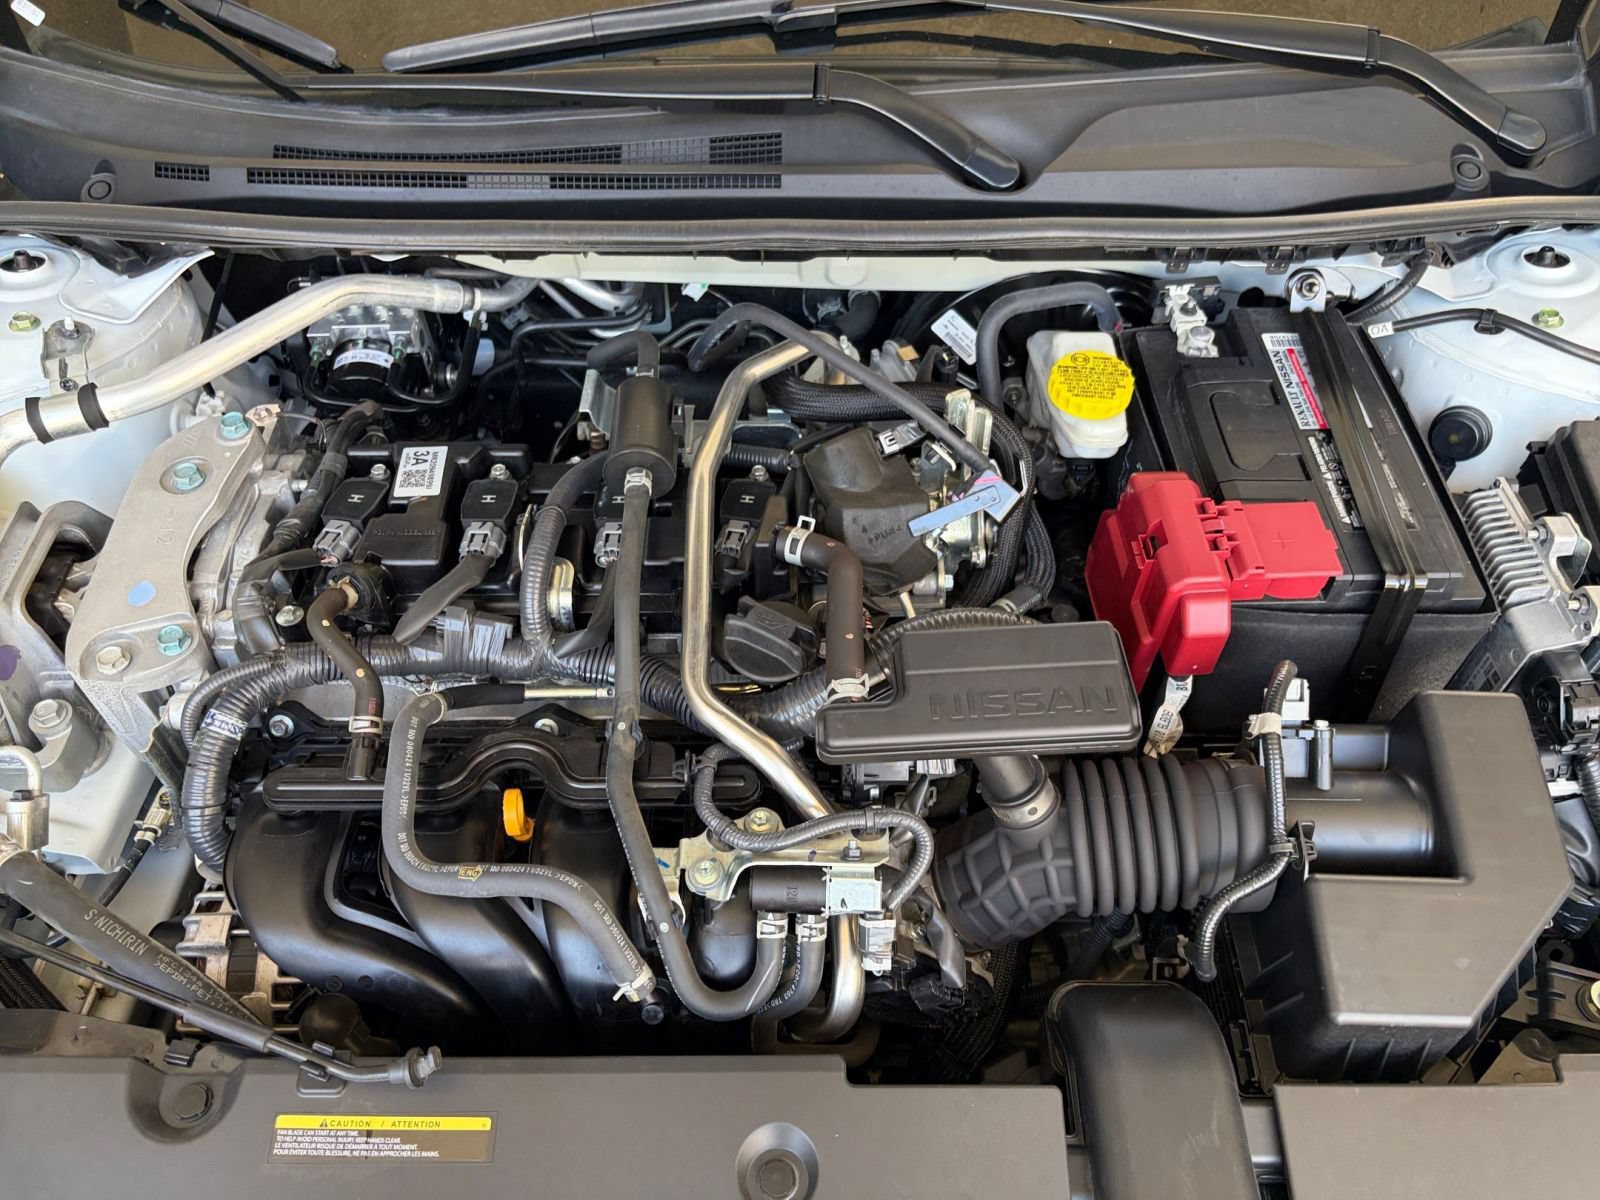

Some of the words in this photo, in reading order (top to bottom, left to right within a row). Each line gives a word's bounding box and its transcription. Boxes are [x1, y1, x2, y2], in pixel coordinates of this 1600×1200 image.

[1271, 350, 1296, 389] NISSAN
[1288, 391, 1311, 428] RENAULT
[411, 450, 430, 466] 3A
[929, 684, 1119, 721] NISSAN
[460, 868, 480, 877] ENG
[330, 1120, 371, 1128] CAUTION
[391, 1120, 441, 1128] ATTENTION
